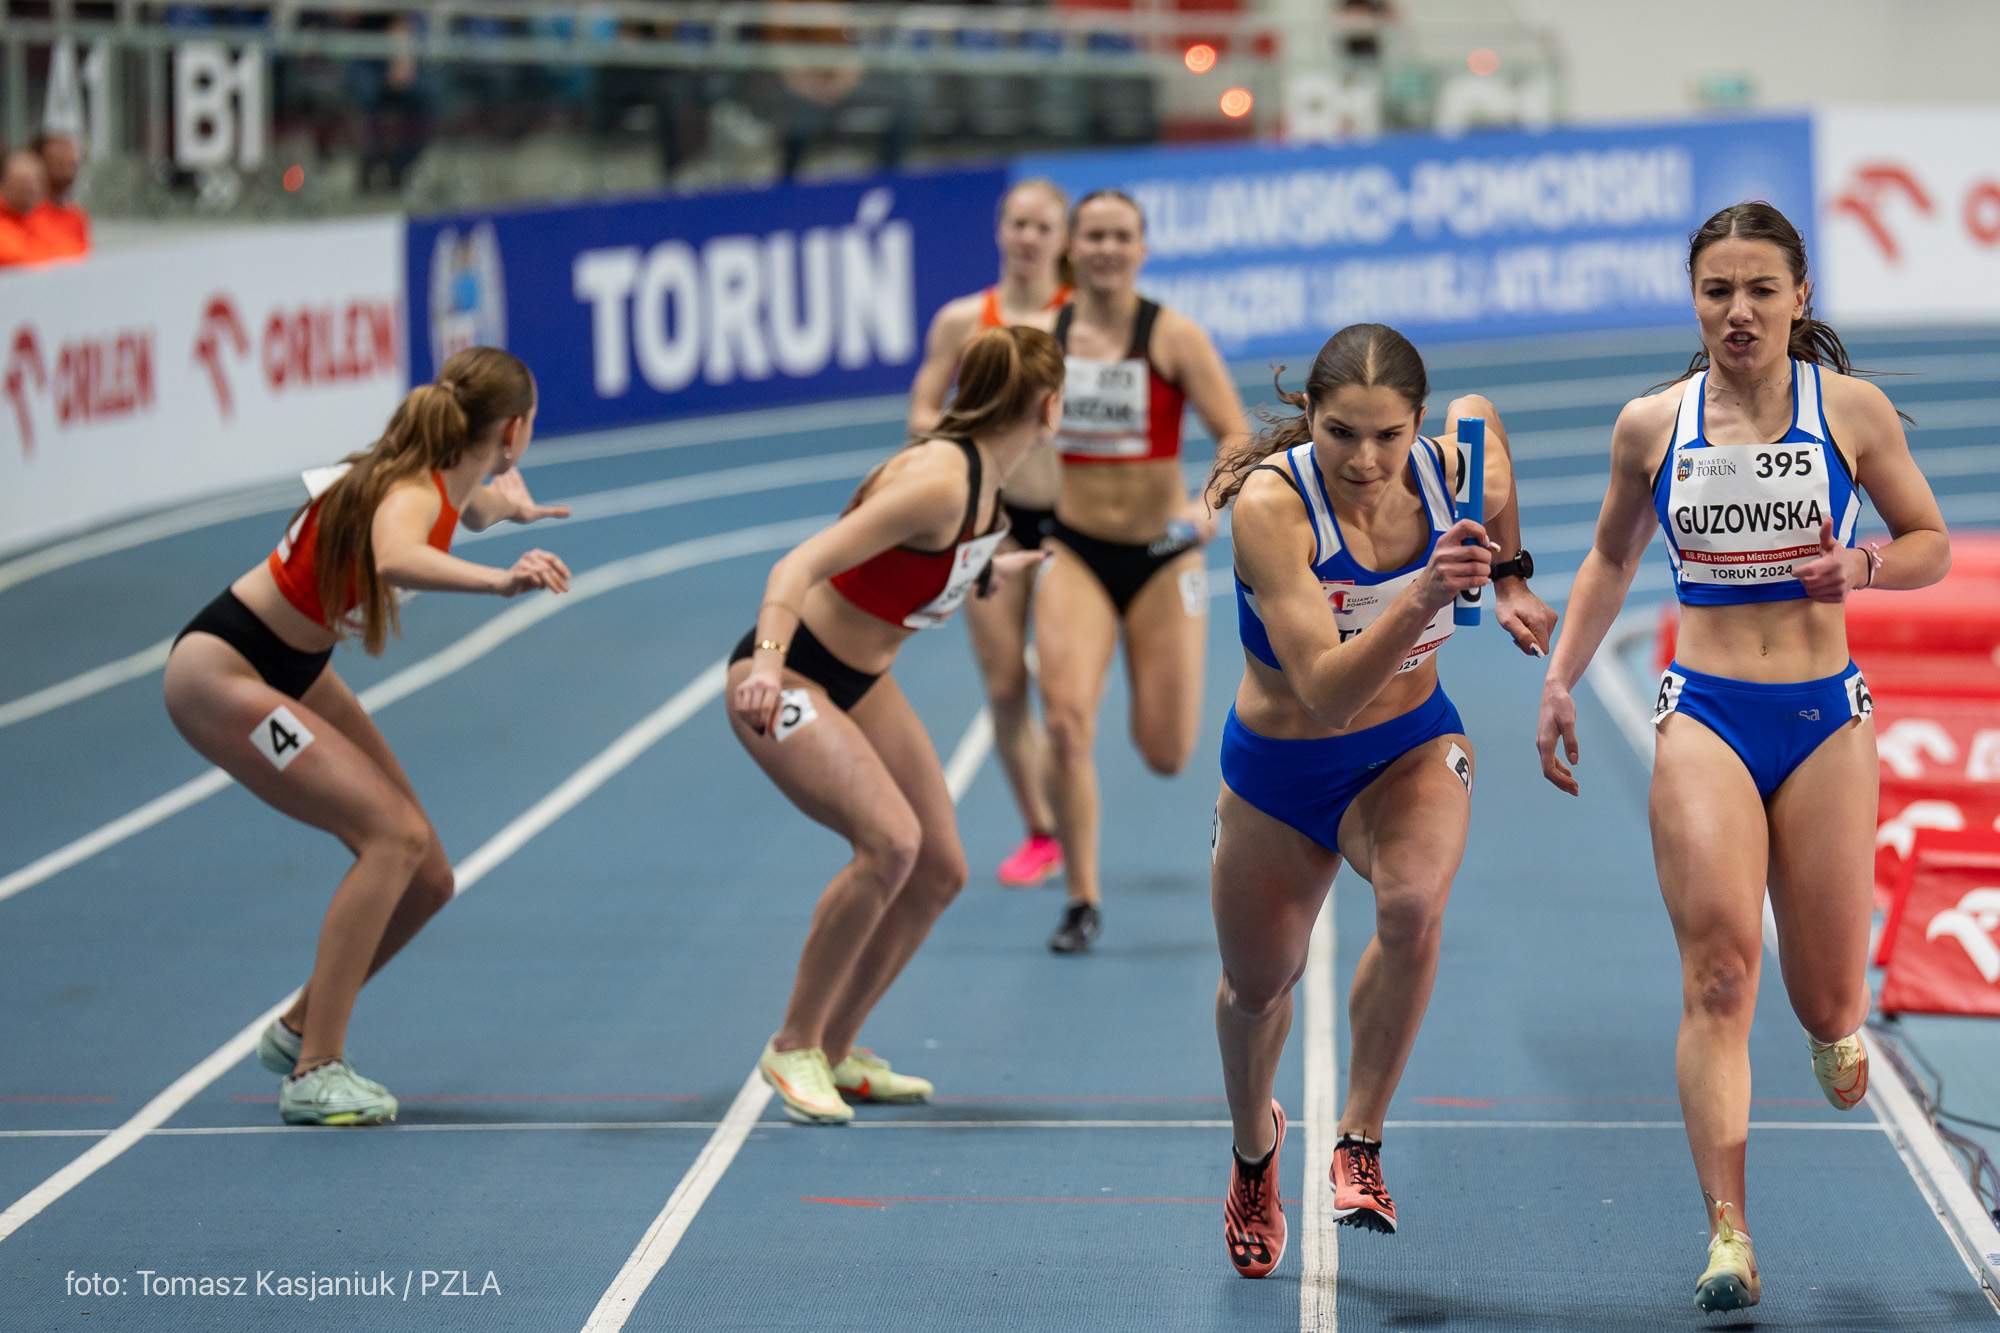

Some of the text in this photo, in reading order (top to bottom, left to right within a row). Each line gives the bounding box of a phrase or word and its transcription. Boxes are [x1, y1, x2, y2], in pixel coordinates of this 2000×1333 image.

[174, 40, 266, 171] B1
[573, 188, 914, 397] TORUŃ
[264, 303, 399, 392] ORLEN
[56, 329, 156, 428] ORLEN
[1696, 462, 1737, 477] TORUŃ
[1755, 450, 1812, 478] 395
[1675, 499, 1823, 535] GUZOWSKA
[1711, 564, 1794, 579] TORUŃ 2024
[1713, 555, 1745, 563] Halowe
[1747, 550, 1797, 562] Mistrzostwa
[1346, 595, 1374, 603] KUJAWY
[1346, 599, 1379, 608] POMORZE
[1655, 675, 1673, 717] 6
[1855, 676, 1874, 715] 6
[269, 717, 300, 757] 4
